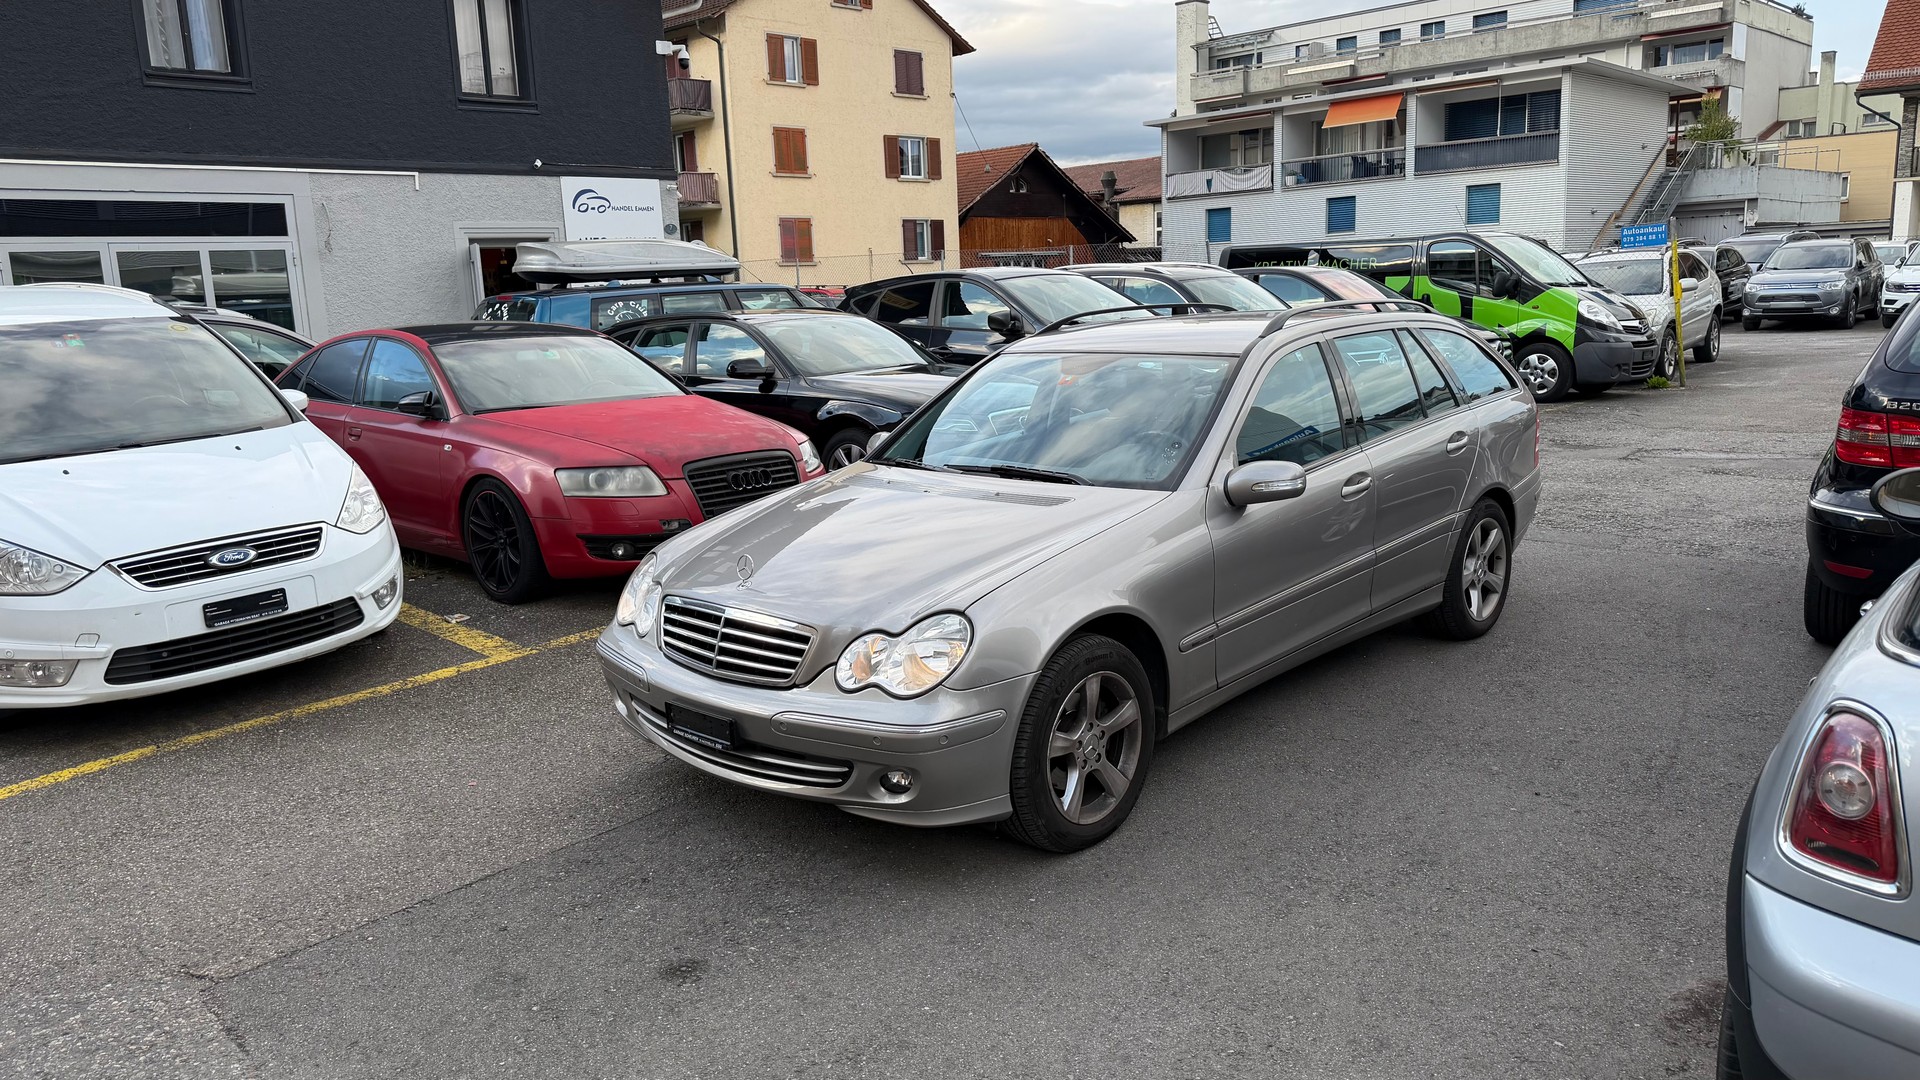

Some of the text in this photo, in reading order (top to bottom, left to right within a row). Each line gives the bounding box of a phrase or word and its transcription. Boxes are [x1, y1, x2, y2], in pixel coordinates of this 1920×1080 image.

[1623, 225, 1665, 235] Autoankauf
[1318, 257, 1377, 270] MACHER
[607, 300, 648, 317] Carp Club
[223, 552, 245, 563] Ford
